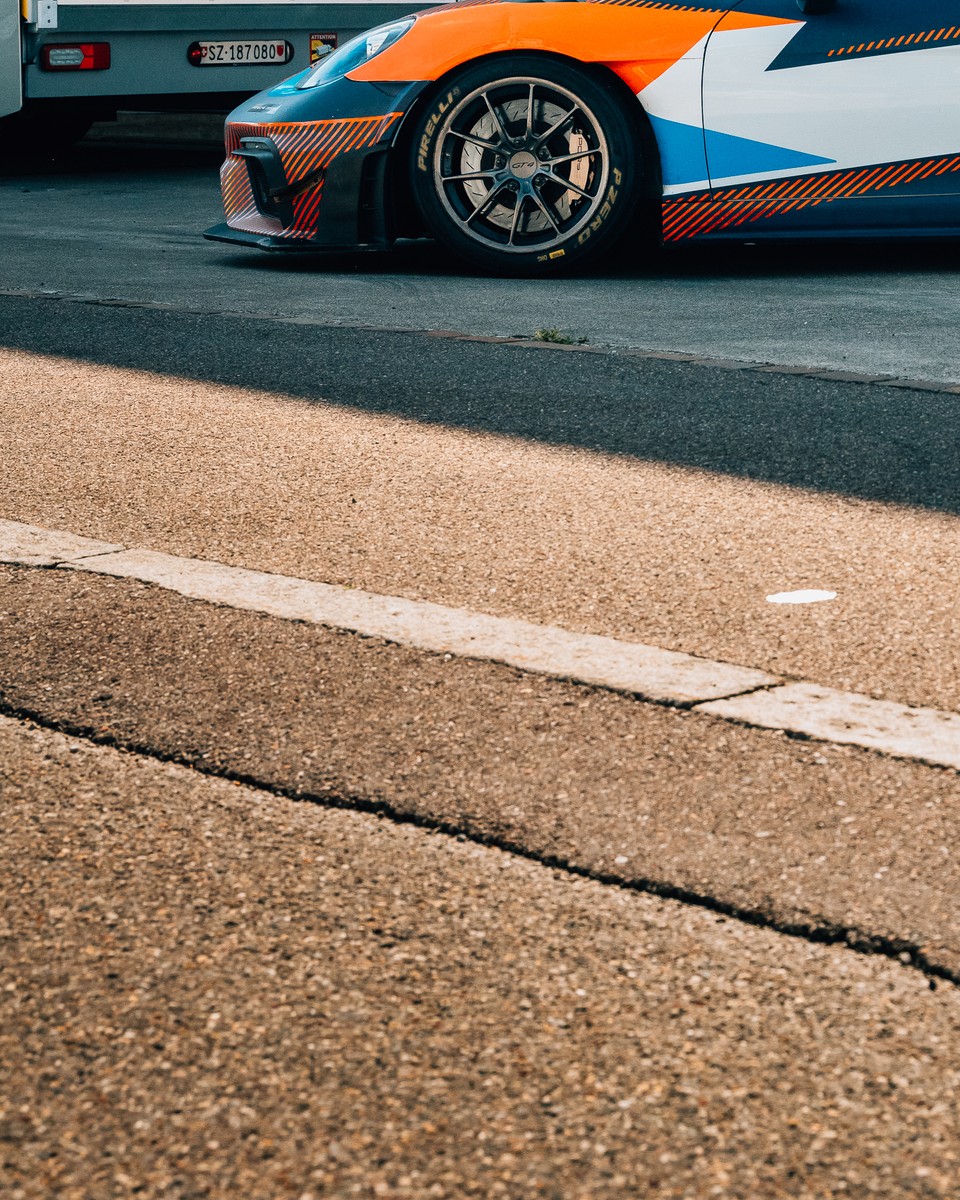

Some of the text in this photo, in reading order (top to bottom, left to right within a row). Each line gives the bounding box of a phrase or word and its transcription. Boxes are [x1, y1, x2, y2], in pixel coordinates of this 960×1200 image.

[418, 91, 454, 172] PIRELLI
[578, 167, 622, 245] P ZERO
